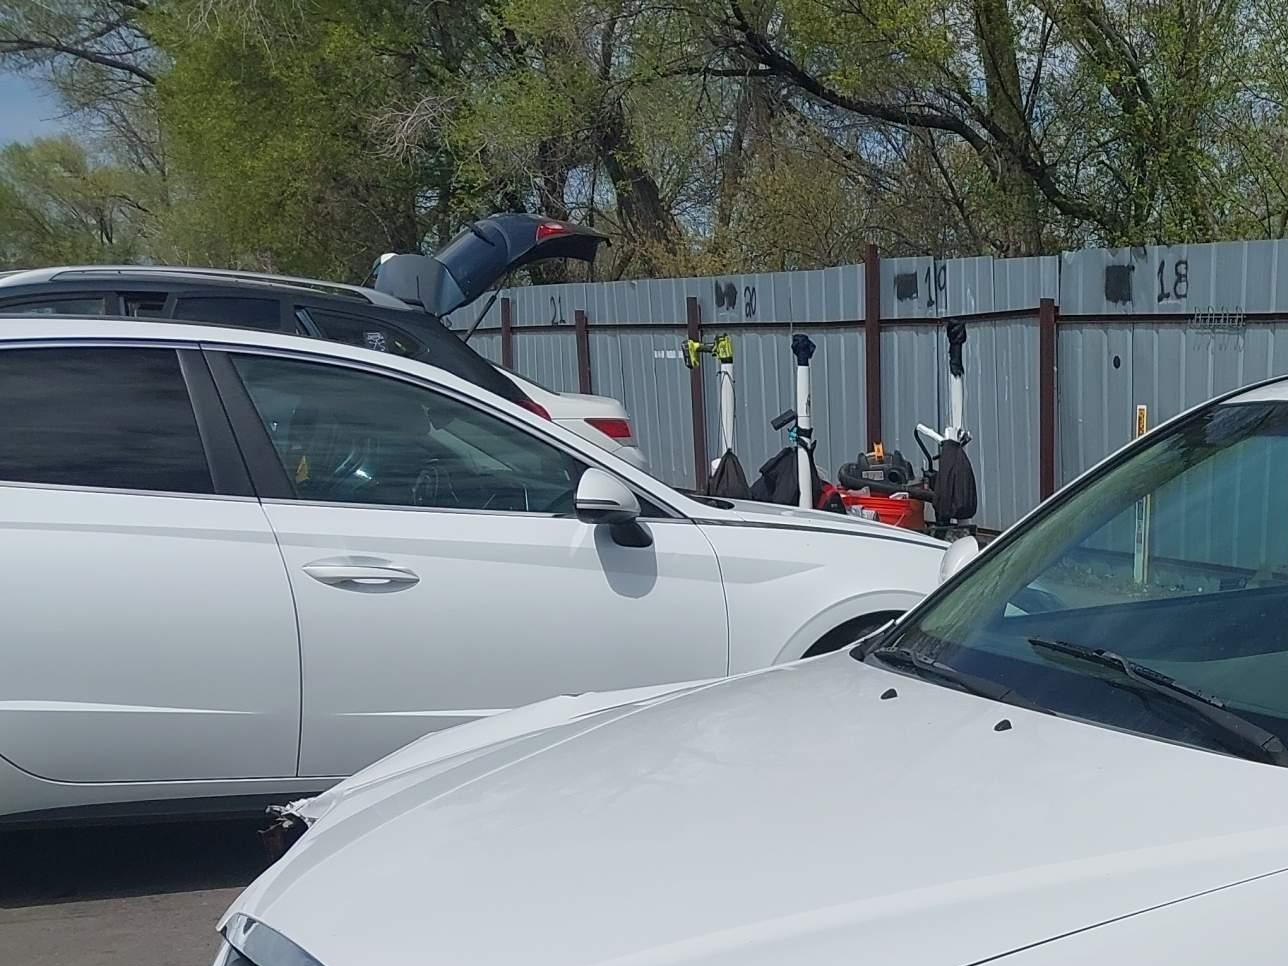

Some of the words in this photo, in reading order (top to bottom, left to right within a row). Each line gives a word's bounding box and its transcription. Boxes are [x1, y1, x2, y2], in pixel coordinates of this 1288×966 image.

[924, 266, 947, 310] 19
[1157, 260, 1188, 302] 18
[550, 297, 565, 325] 21
[744, 287, 757, 318] 20
